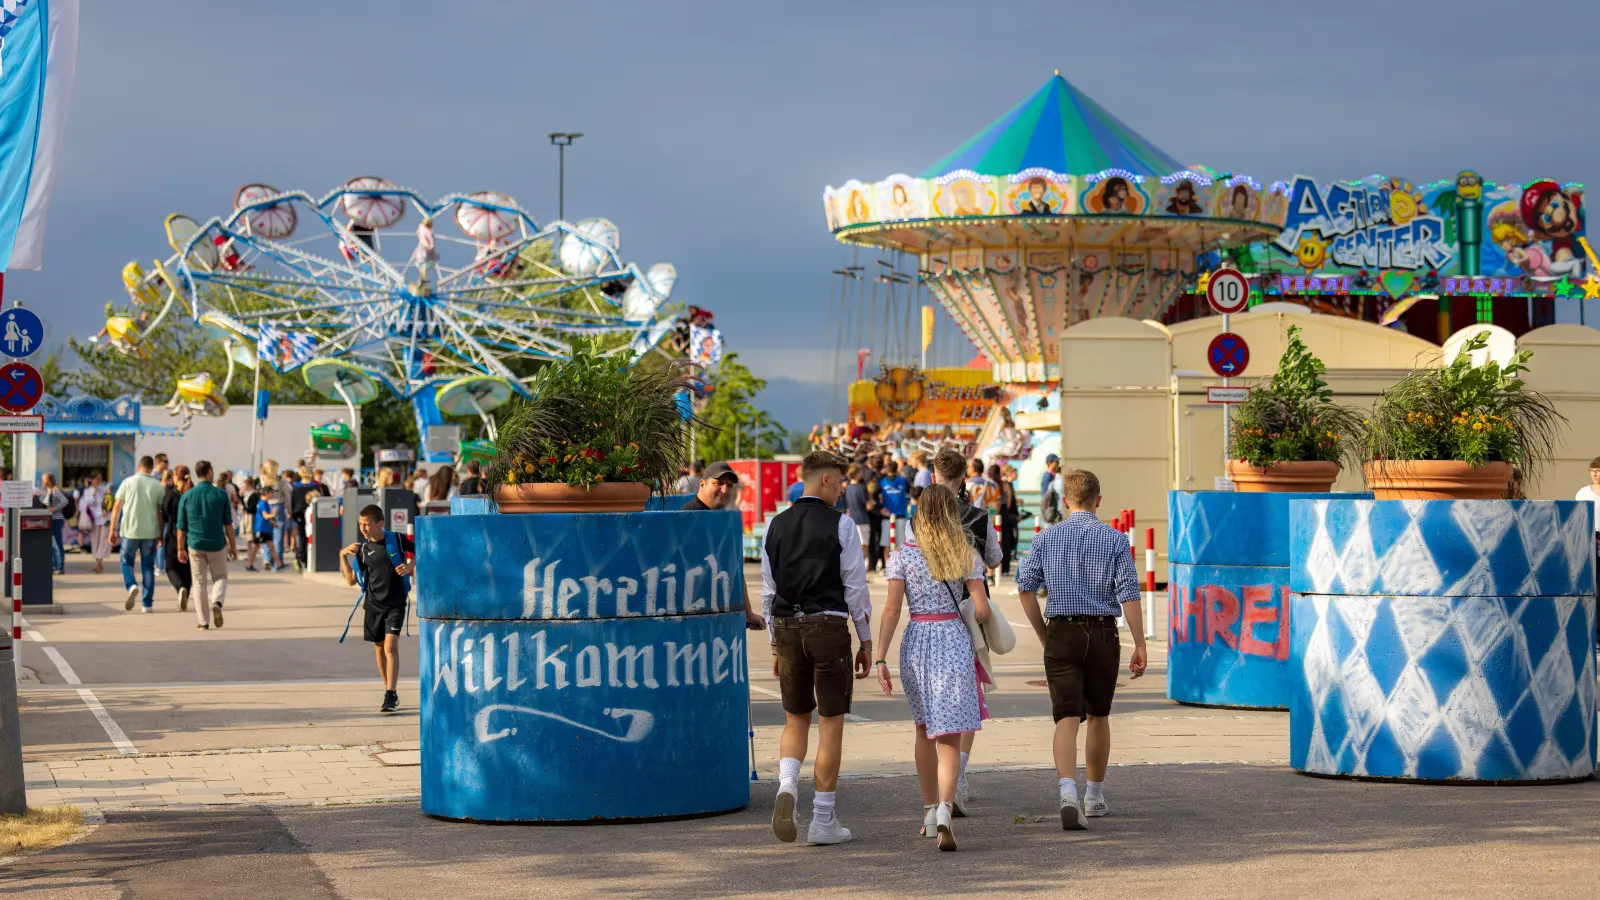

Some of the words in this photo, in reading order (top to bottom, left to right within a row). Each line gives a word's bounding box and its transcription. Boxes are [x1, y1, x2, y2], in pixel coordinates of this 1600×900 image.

[1333, 215, 1451, 269] CENTER
[1218, 281, 1238, 301] 10
[522, 553, 731, 619] Herzlich
[432, 621, 745, 698] Willkommen
